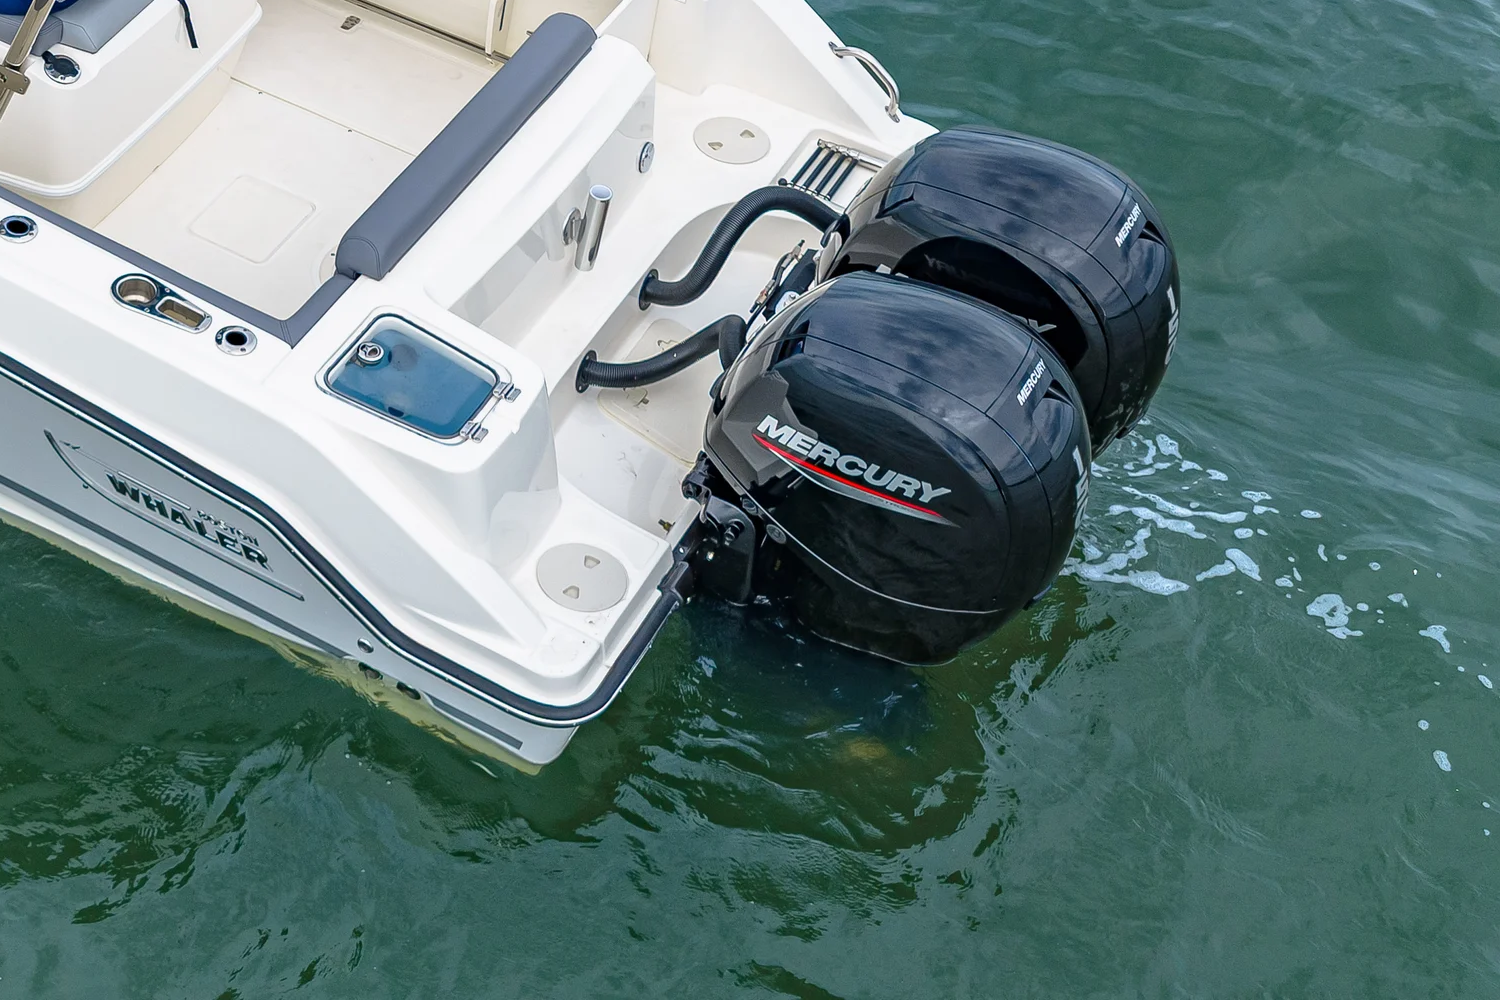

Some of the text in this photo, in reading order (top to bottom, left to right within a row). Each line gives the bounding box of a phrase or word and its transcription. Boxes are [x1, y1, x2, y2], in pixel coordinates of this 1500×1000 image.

[1114, 202, 1142, 248] MERCURY
[1016, 358, 1047, 406] MERCURY
[756, 414, 952, 504] MERCURY
[105, 471, 274, 572] WHALER
